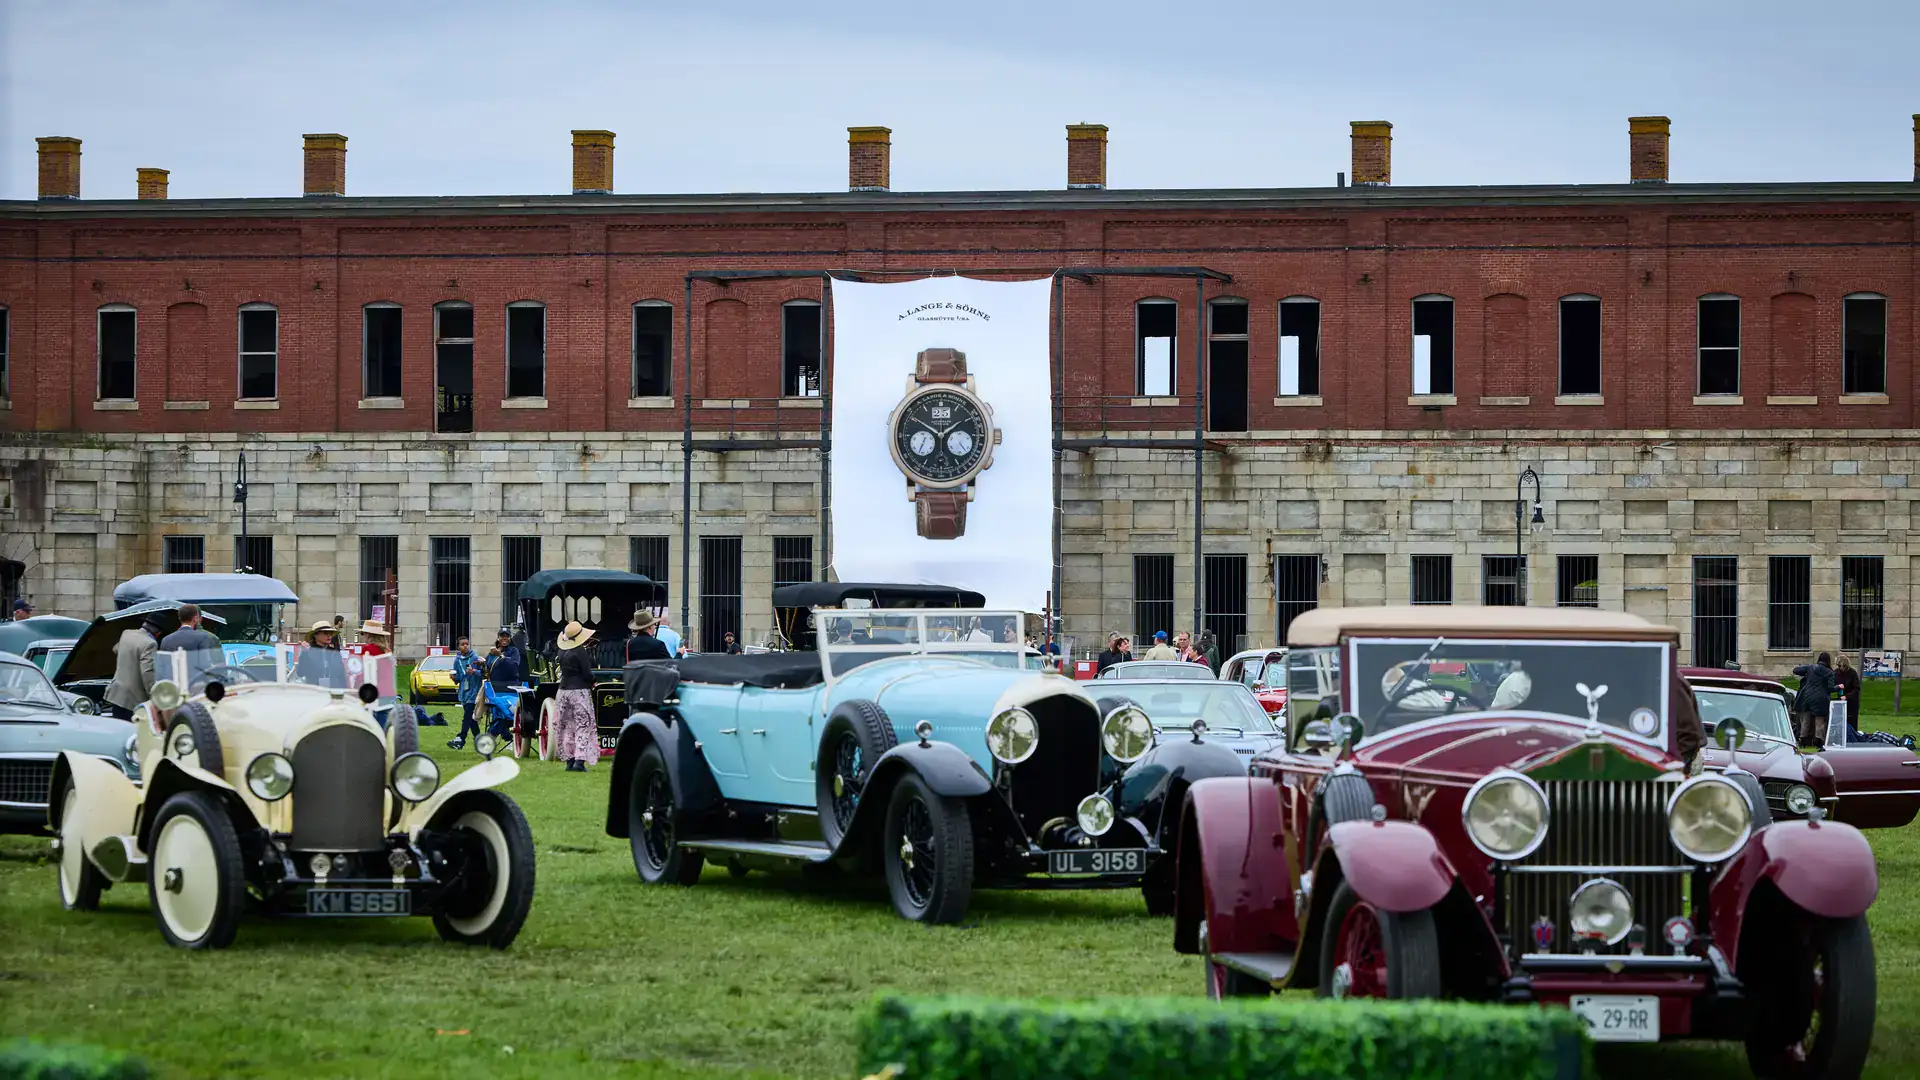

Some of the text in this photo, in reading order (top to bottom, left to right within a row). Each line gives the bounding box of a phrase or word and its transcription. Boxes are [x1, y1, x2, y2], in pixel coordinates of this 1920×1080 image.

[955, 304, 991, 321] SÖHNE
[933, 409, 949, 417] 25
[1056, 851, 1138, 872] UL 3158
[313, 892, 405, 912] KM 9651
